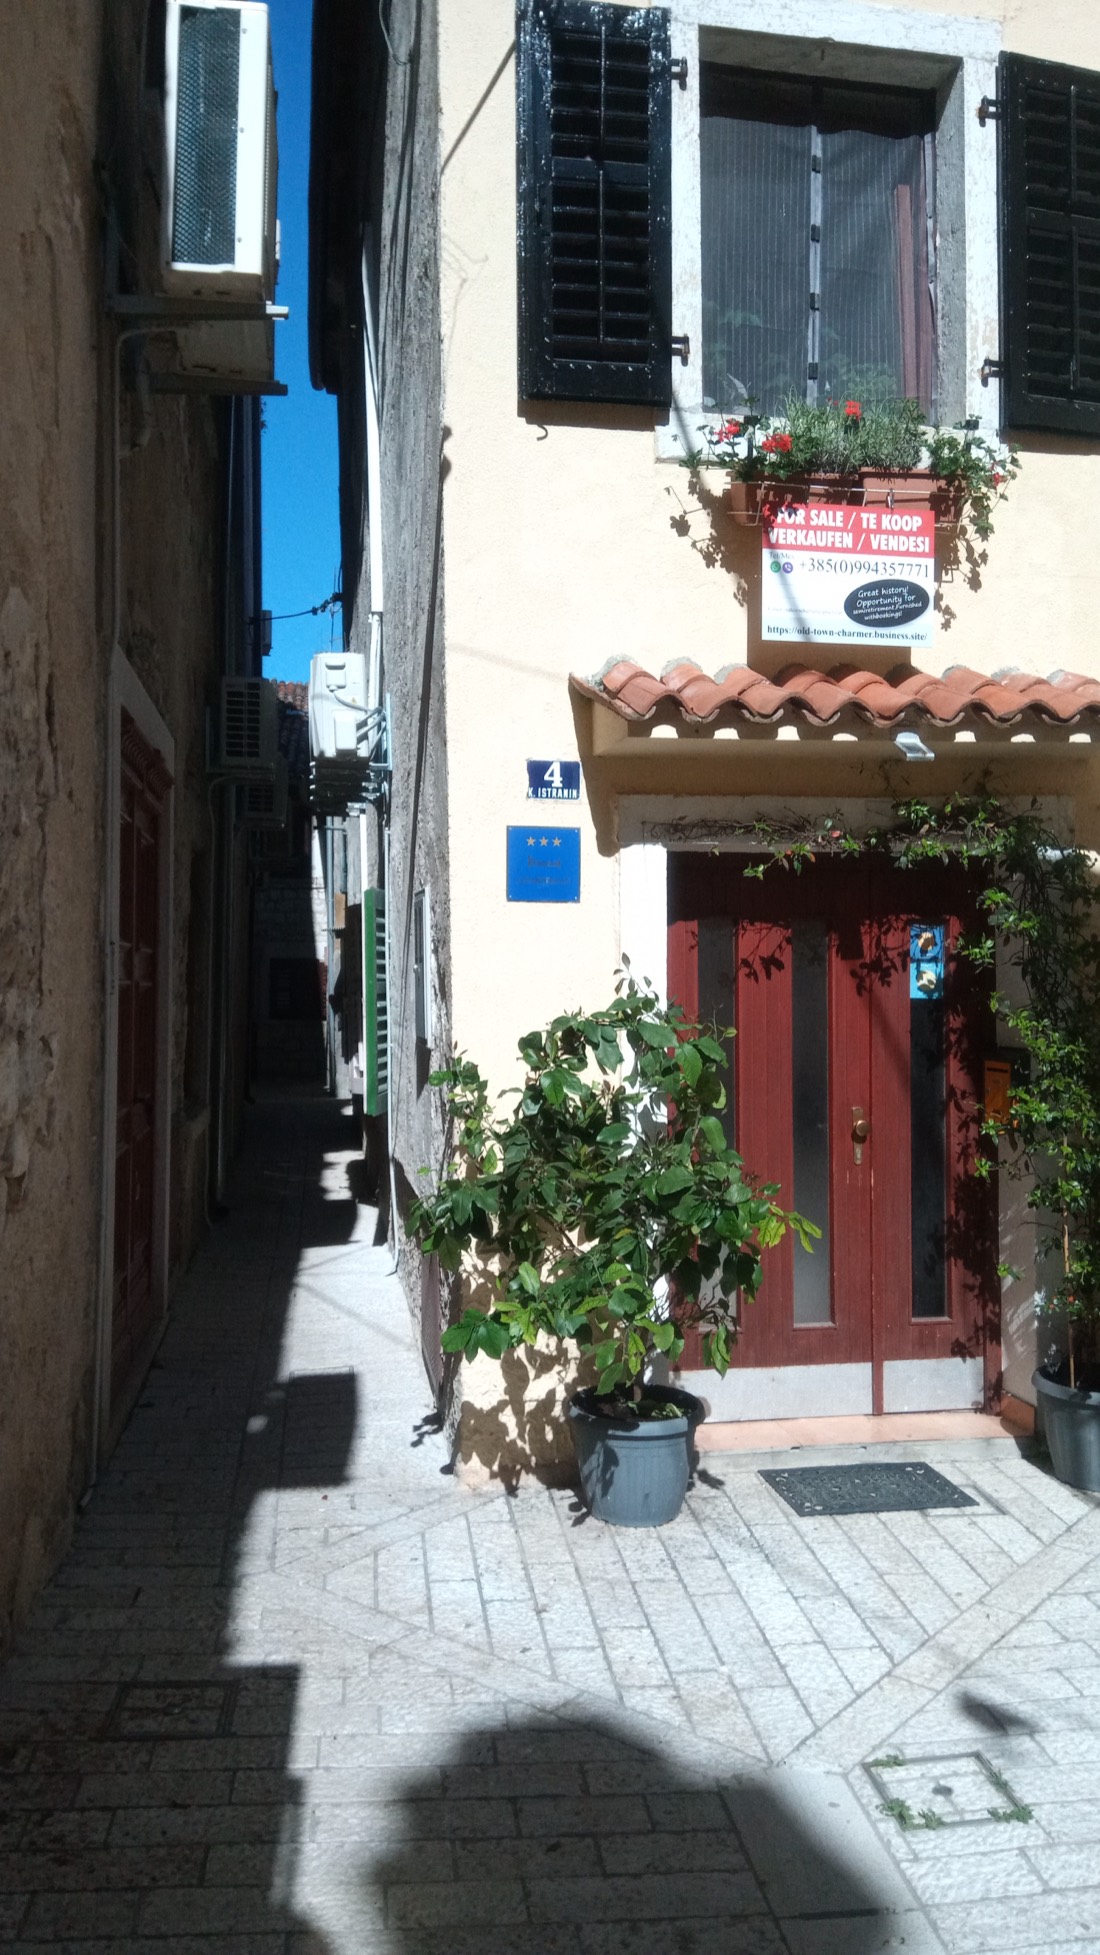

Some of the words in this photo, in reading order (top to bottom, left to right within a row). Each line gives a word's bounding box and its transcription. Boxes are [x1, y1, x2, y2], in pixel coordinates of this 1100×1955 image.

[777, 508, 806, 525] FOR
[810, 510, 844, 527] SALE
[848, 512, 857, 529] /
[861, 512, 877, 529] TE
[881, 514, 922, 532] KOOP
[768, 527, 853, 548] VERKAUFEN
[857, 533, 866, 551] /
[870, 534, 930, 553] VENDESI
[800, 557, 929, 578] +385(0)994357771
[856, 595, 902, 609] Opportunity
[904, 594, 916, 602] for
[858, 589, 879, 598] Great
[881, 585, 909, 595] history!
[767, 625, 927, 641] https://old-town-charmer.business.site/
[543, 761, 563, 787] 4
